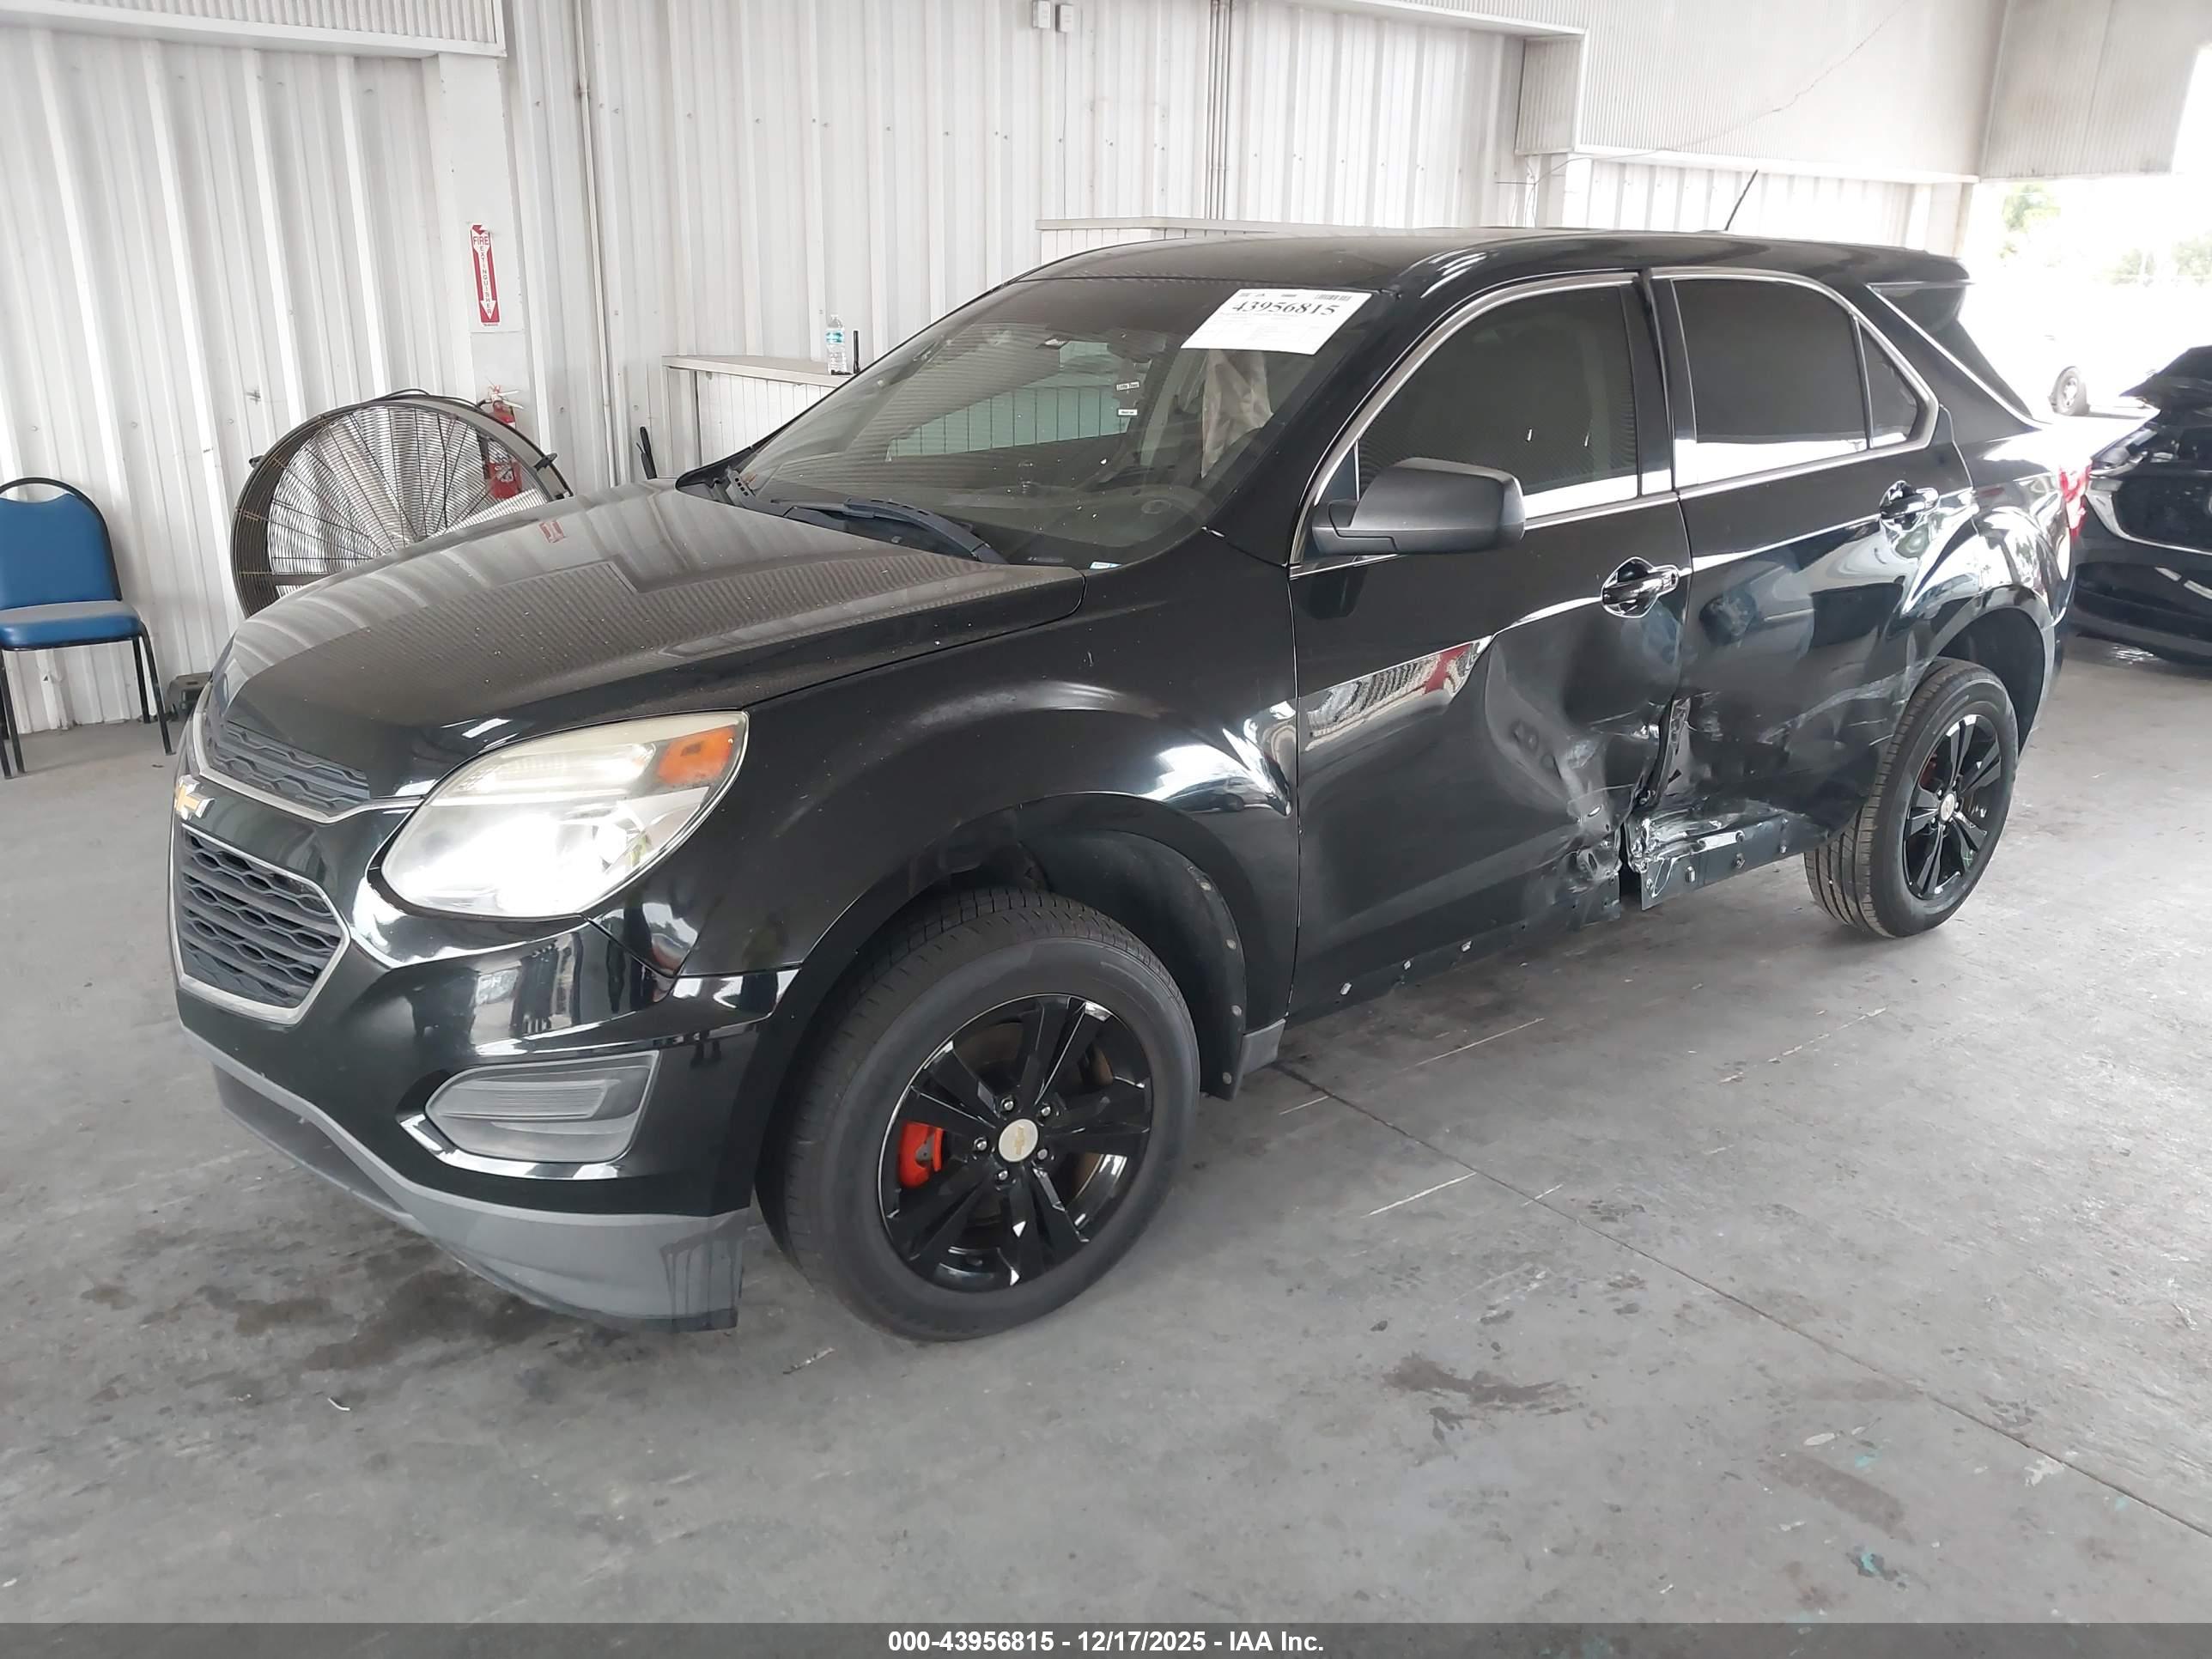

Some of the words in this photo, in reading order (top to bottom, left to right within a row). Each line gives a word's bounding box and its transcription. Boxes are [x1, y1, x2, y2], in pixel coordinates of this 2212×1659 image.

[473, 236, 489, 246] FIRE
[479, 246, 492, 314] EXTINGUISHER
[1231, 301, 1340, 316] 43956815
